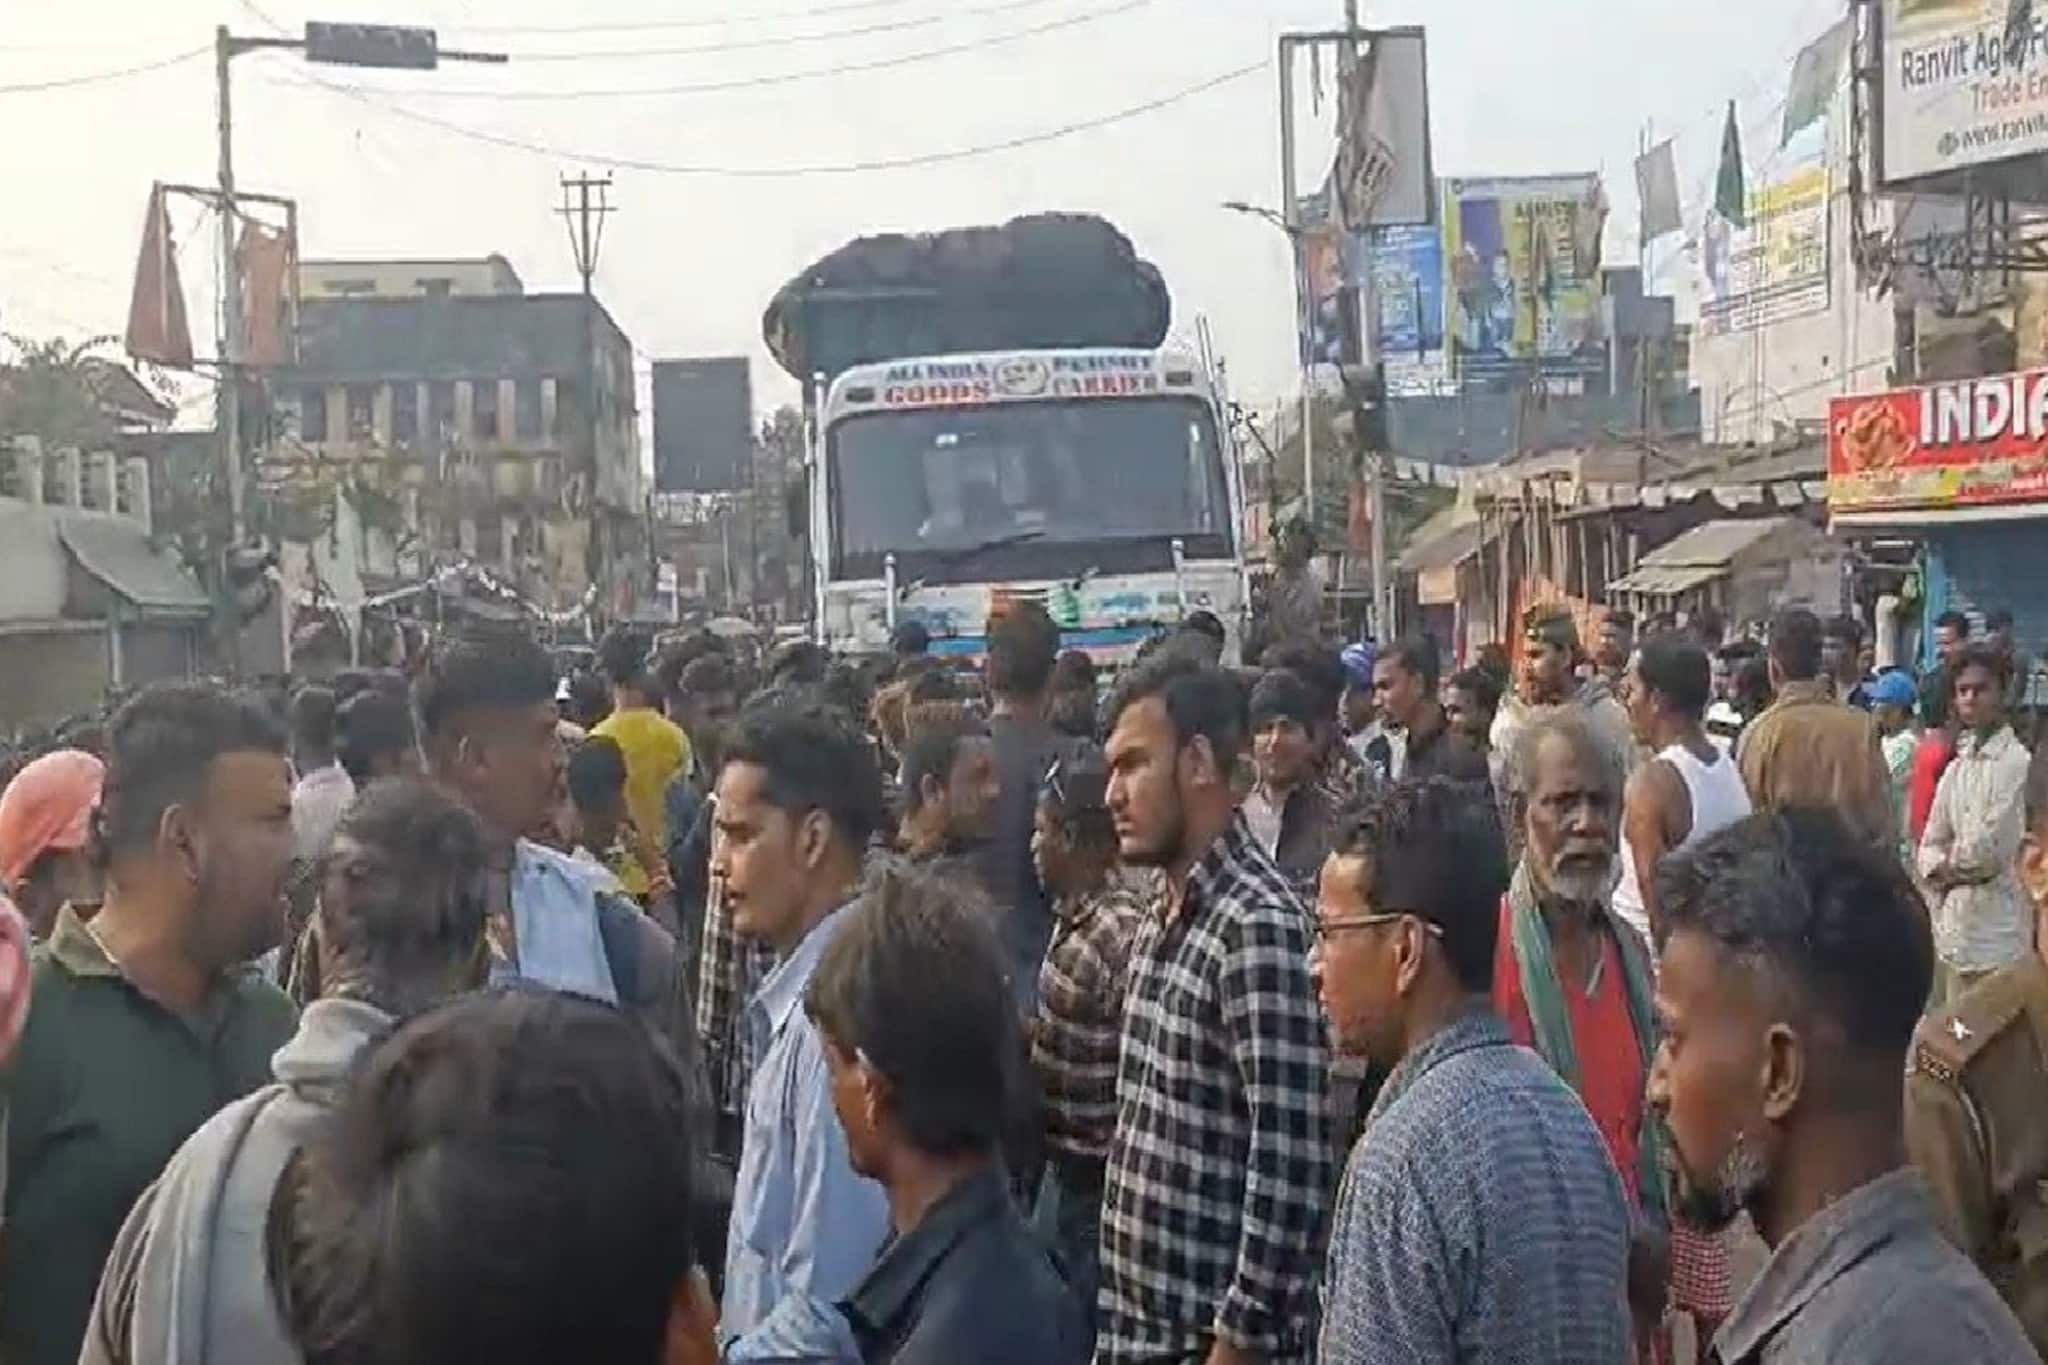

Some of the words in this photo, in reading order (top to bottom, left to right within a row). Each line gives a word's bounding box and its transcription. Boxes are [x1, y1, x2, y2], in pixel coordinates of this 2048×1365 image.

[1901, 36, 1969, 90] Ranvit
[1970, 75, 2022, 111] Trade
[886, 365, 924, 382] ALL
[928, 361, 988, 379] INDIA
[885, 380, 992, 403] GOODS
